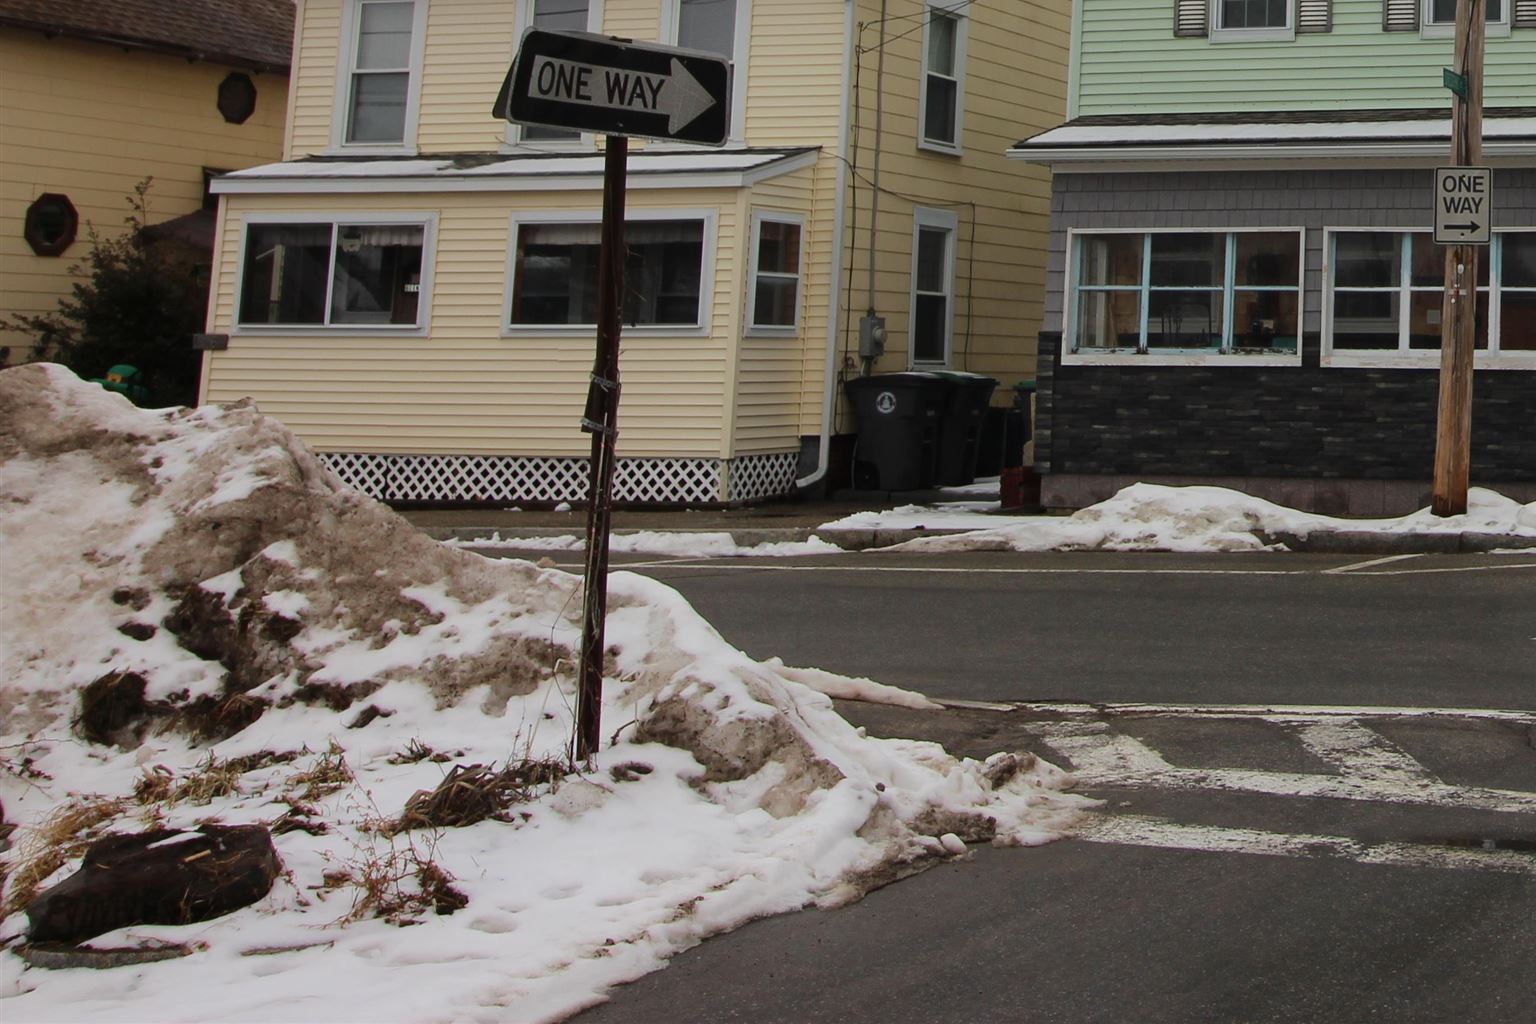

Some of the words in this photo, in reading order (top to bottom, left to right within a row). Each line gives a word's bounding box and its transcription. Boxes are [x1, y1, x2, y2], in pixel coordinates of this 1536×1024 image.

[537, 61, 592, 101] ONE
[605, 70, 666, 110] WAY
[1442, 175, 1484, 193] ONE
[1443, 197, 1484, 214] WAY
